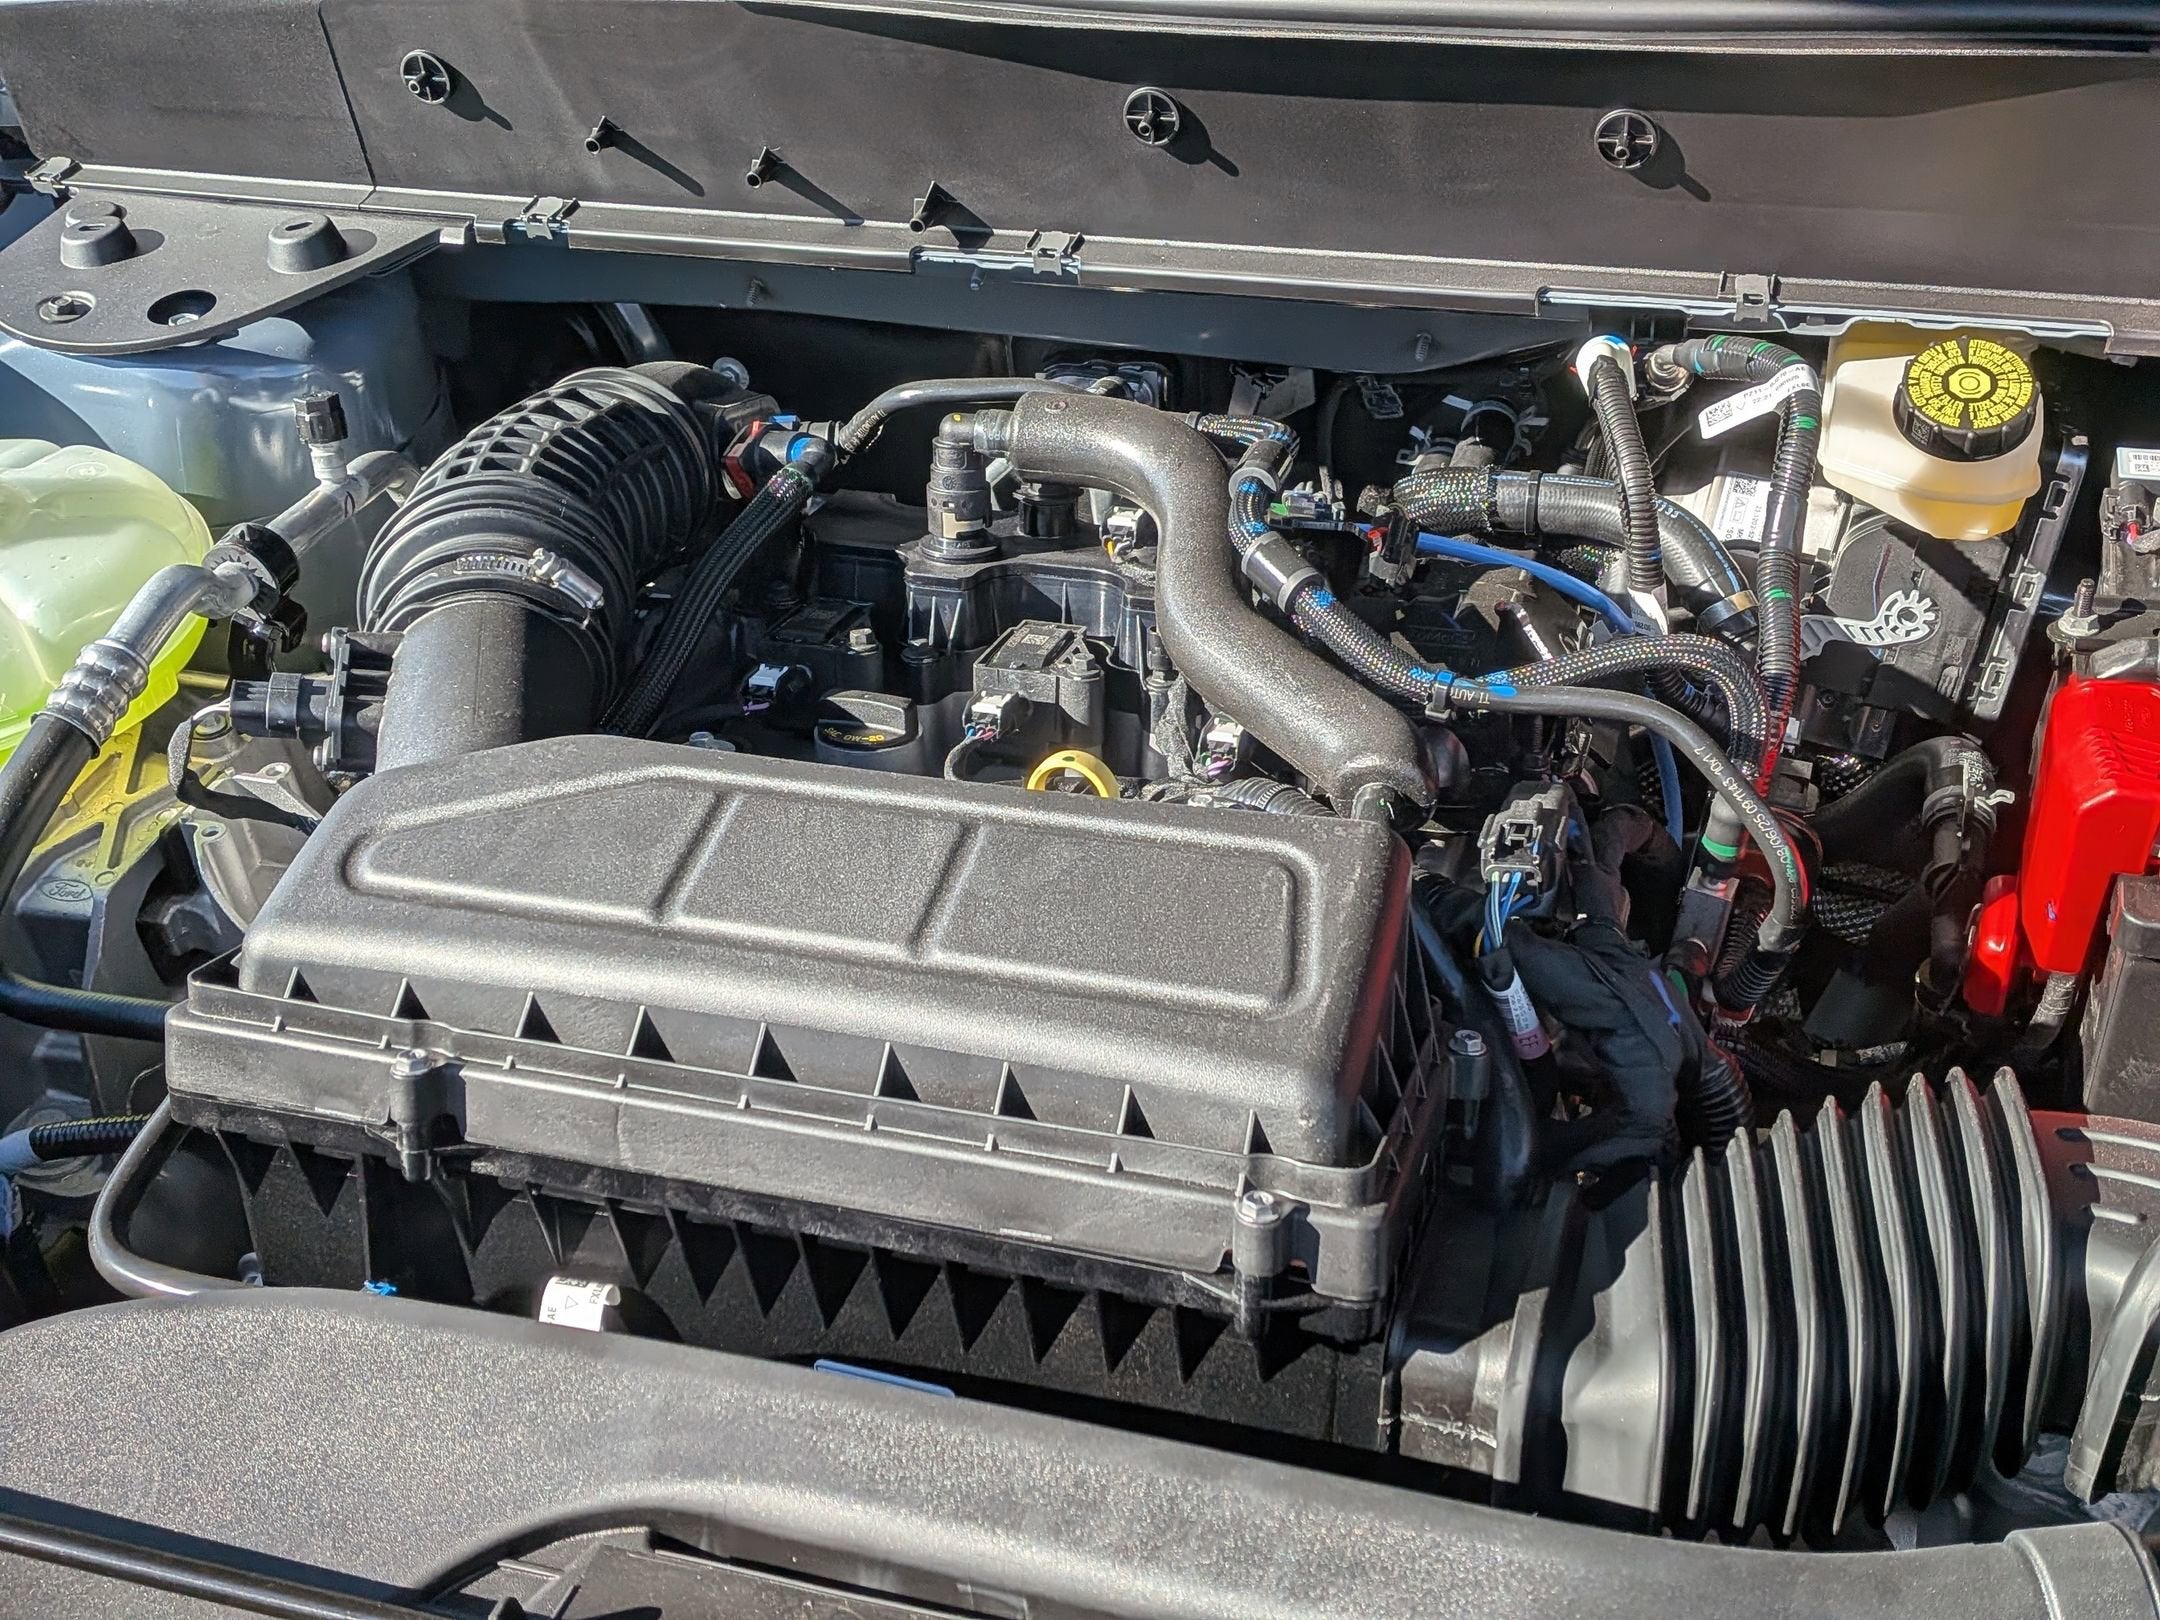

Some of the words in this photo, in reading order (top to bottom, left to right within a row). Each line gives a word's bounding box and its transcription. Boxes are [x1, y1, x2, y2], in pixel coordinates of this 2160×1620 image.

[1942, 340, 1958, 352] DOT
[1947, 349, 1962, 358] CAP
[1969, 339, 2006, 354] ATTENTION
[1934, 357, 1966, 375] WARNING
[1931, 375, 1944, 395] CLEAN
[1909, 385, 1926, 407] SEALED
[1927, 398, 1942, 410] USE
[1938, 394, 1964, 411] FILLER
[1922, 405, 1960, 427] CONTAINER
[1941, 405, 1960, 418] ONLY
[47, 881, 88, 899] Ford
